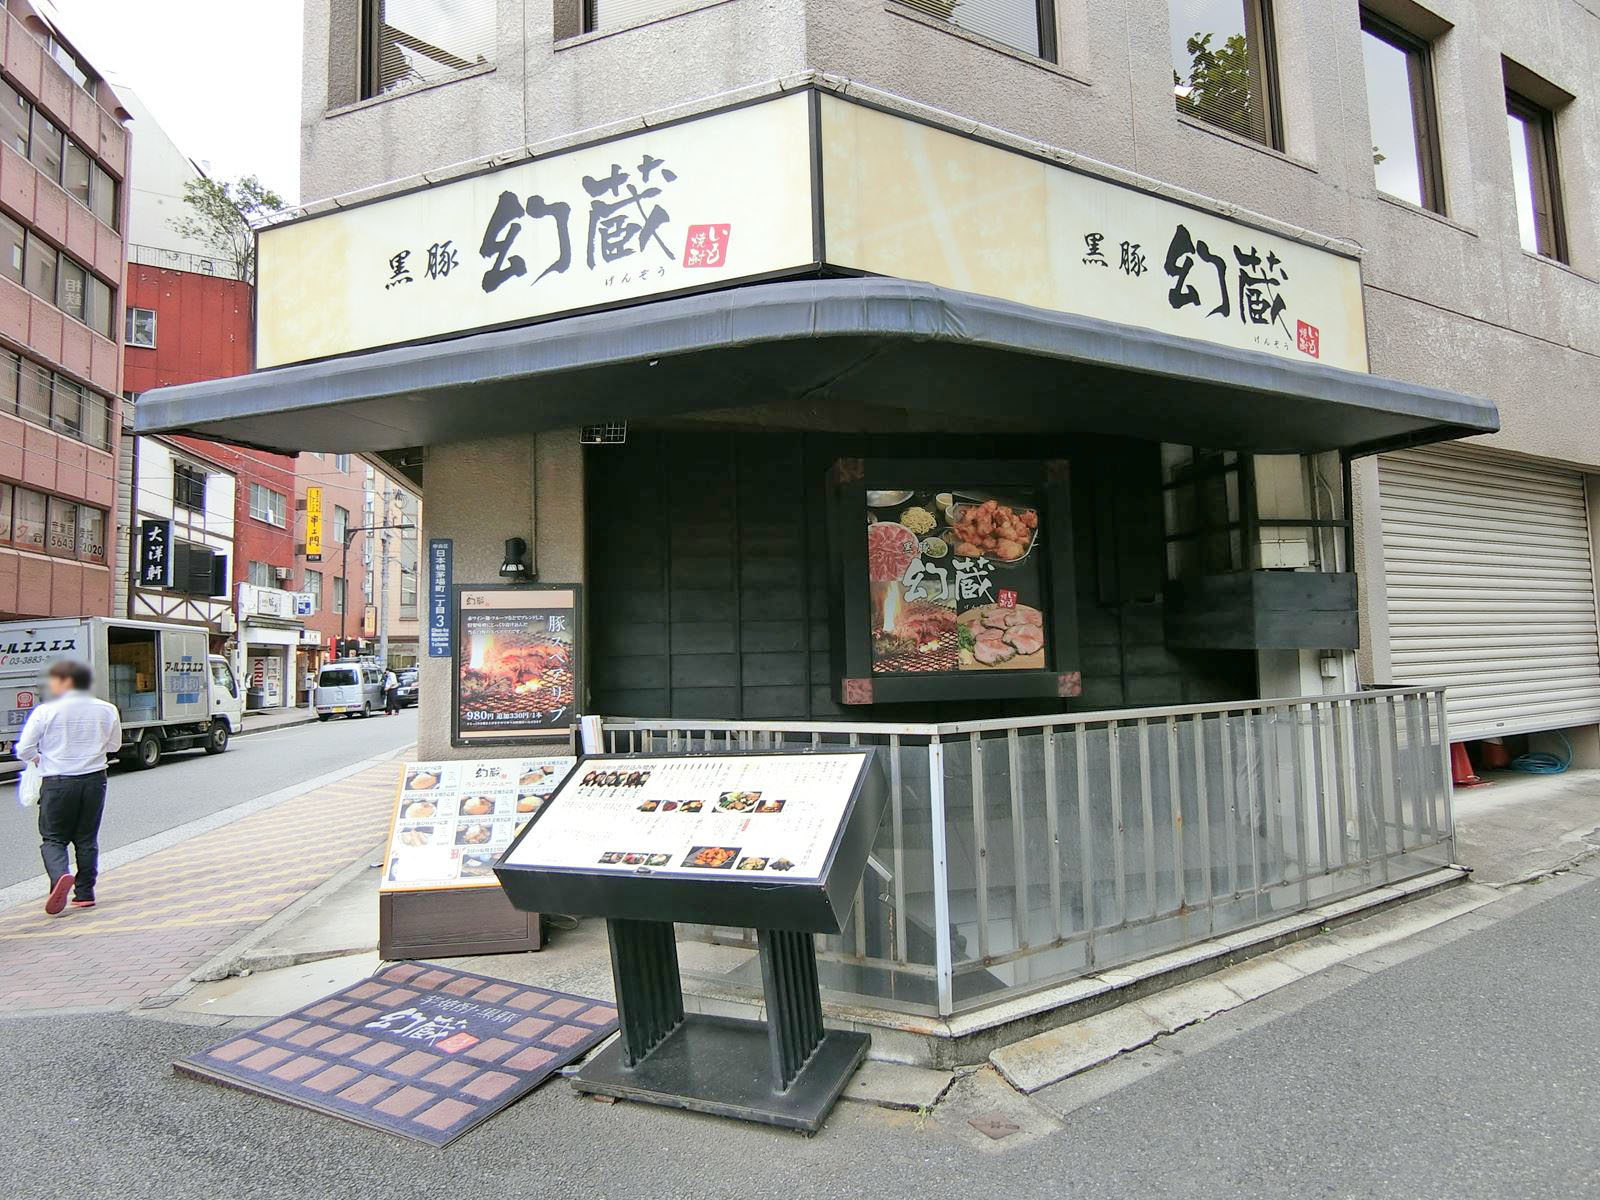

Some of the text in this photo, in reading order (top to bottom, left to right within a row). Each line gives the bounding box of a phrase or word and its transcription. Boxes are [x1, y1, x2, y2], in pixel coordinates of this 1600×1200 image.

[385, 155, 678, 294] 黒豚 幻蔵
[1082, 224, 1293, 341] 黒豚 幻蔵
[146, 526, 164, 581] 大洋軒
[903, 557, 996, 603] 幻蔵
[165, 662, 205, 672] アールエスエス
[549, 615, 567, 723] 豚スペアリブ
[364, 1007, 470, 1049] 幻蔵
